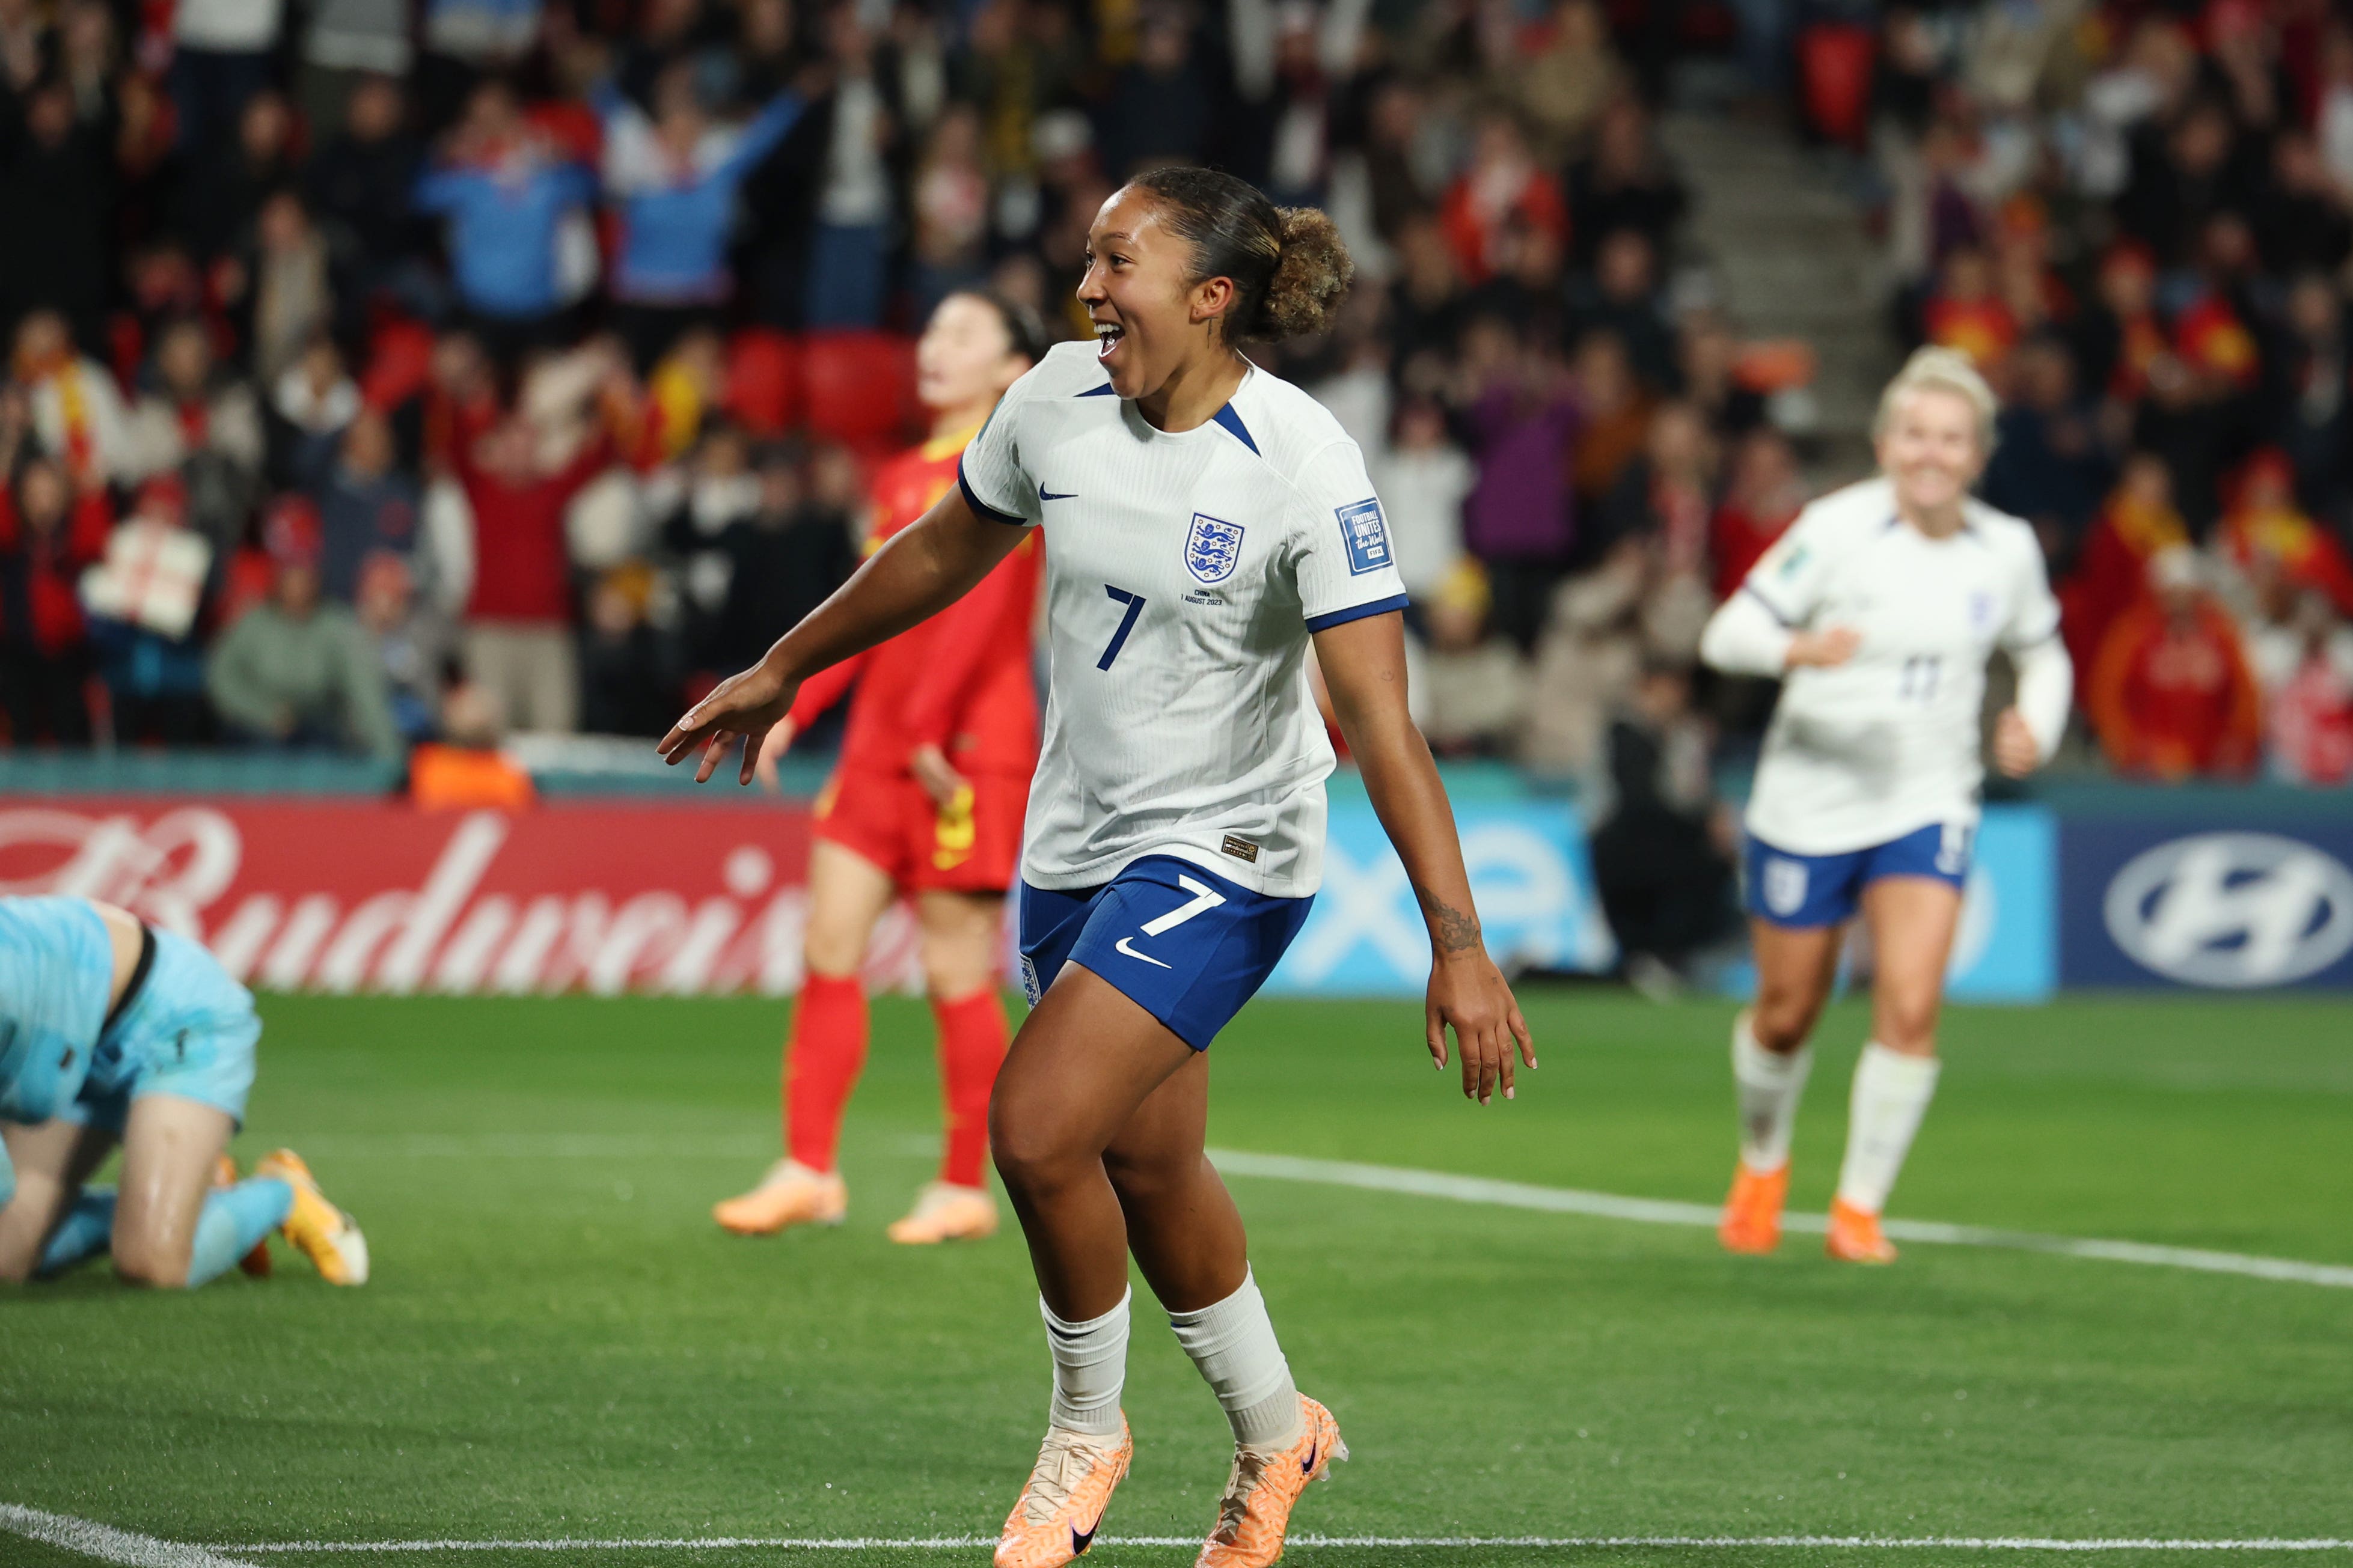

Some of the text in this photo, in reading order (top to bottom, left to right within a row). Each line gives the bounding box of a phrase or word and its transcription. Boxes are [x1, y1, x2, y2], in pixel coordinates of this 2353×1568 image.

[1351, 510, 1378, 525] FOOTBALL
[1354, 520, 1381, 537] UNITES
[1355, 532, 1384, 549] the World
[1369, 548, 1382, 557] FIFA
[1185, 595, 1205, 605] AUGUST
[1097, 584, 1147, 672] 7
[1140, 874, 1227, 937] 7
